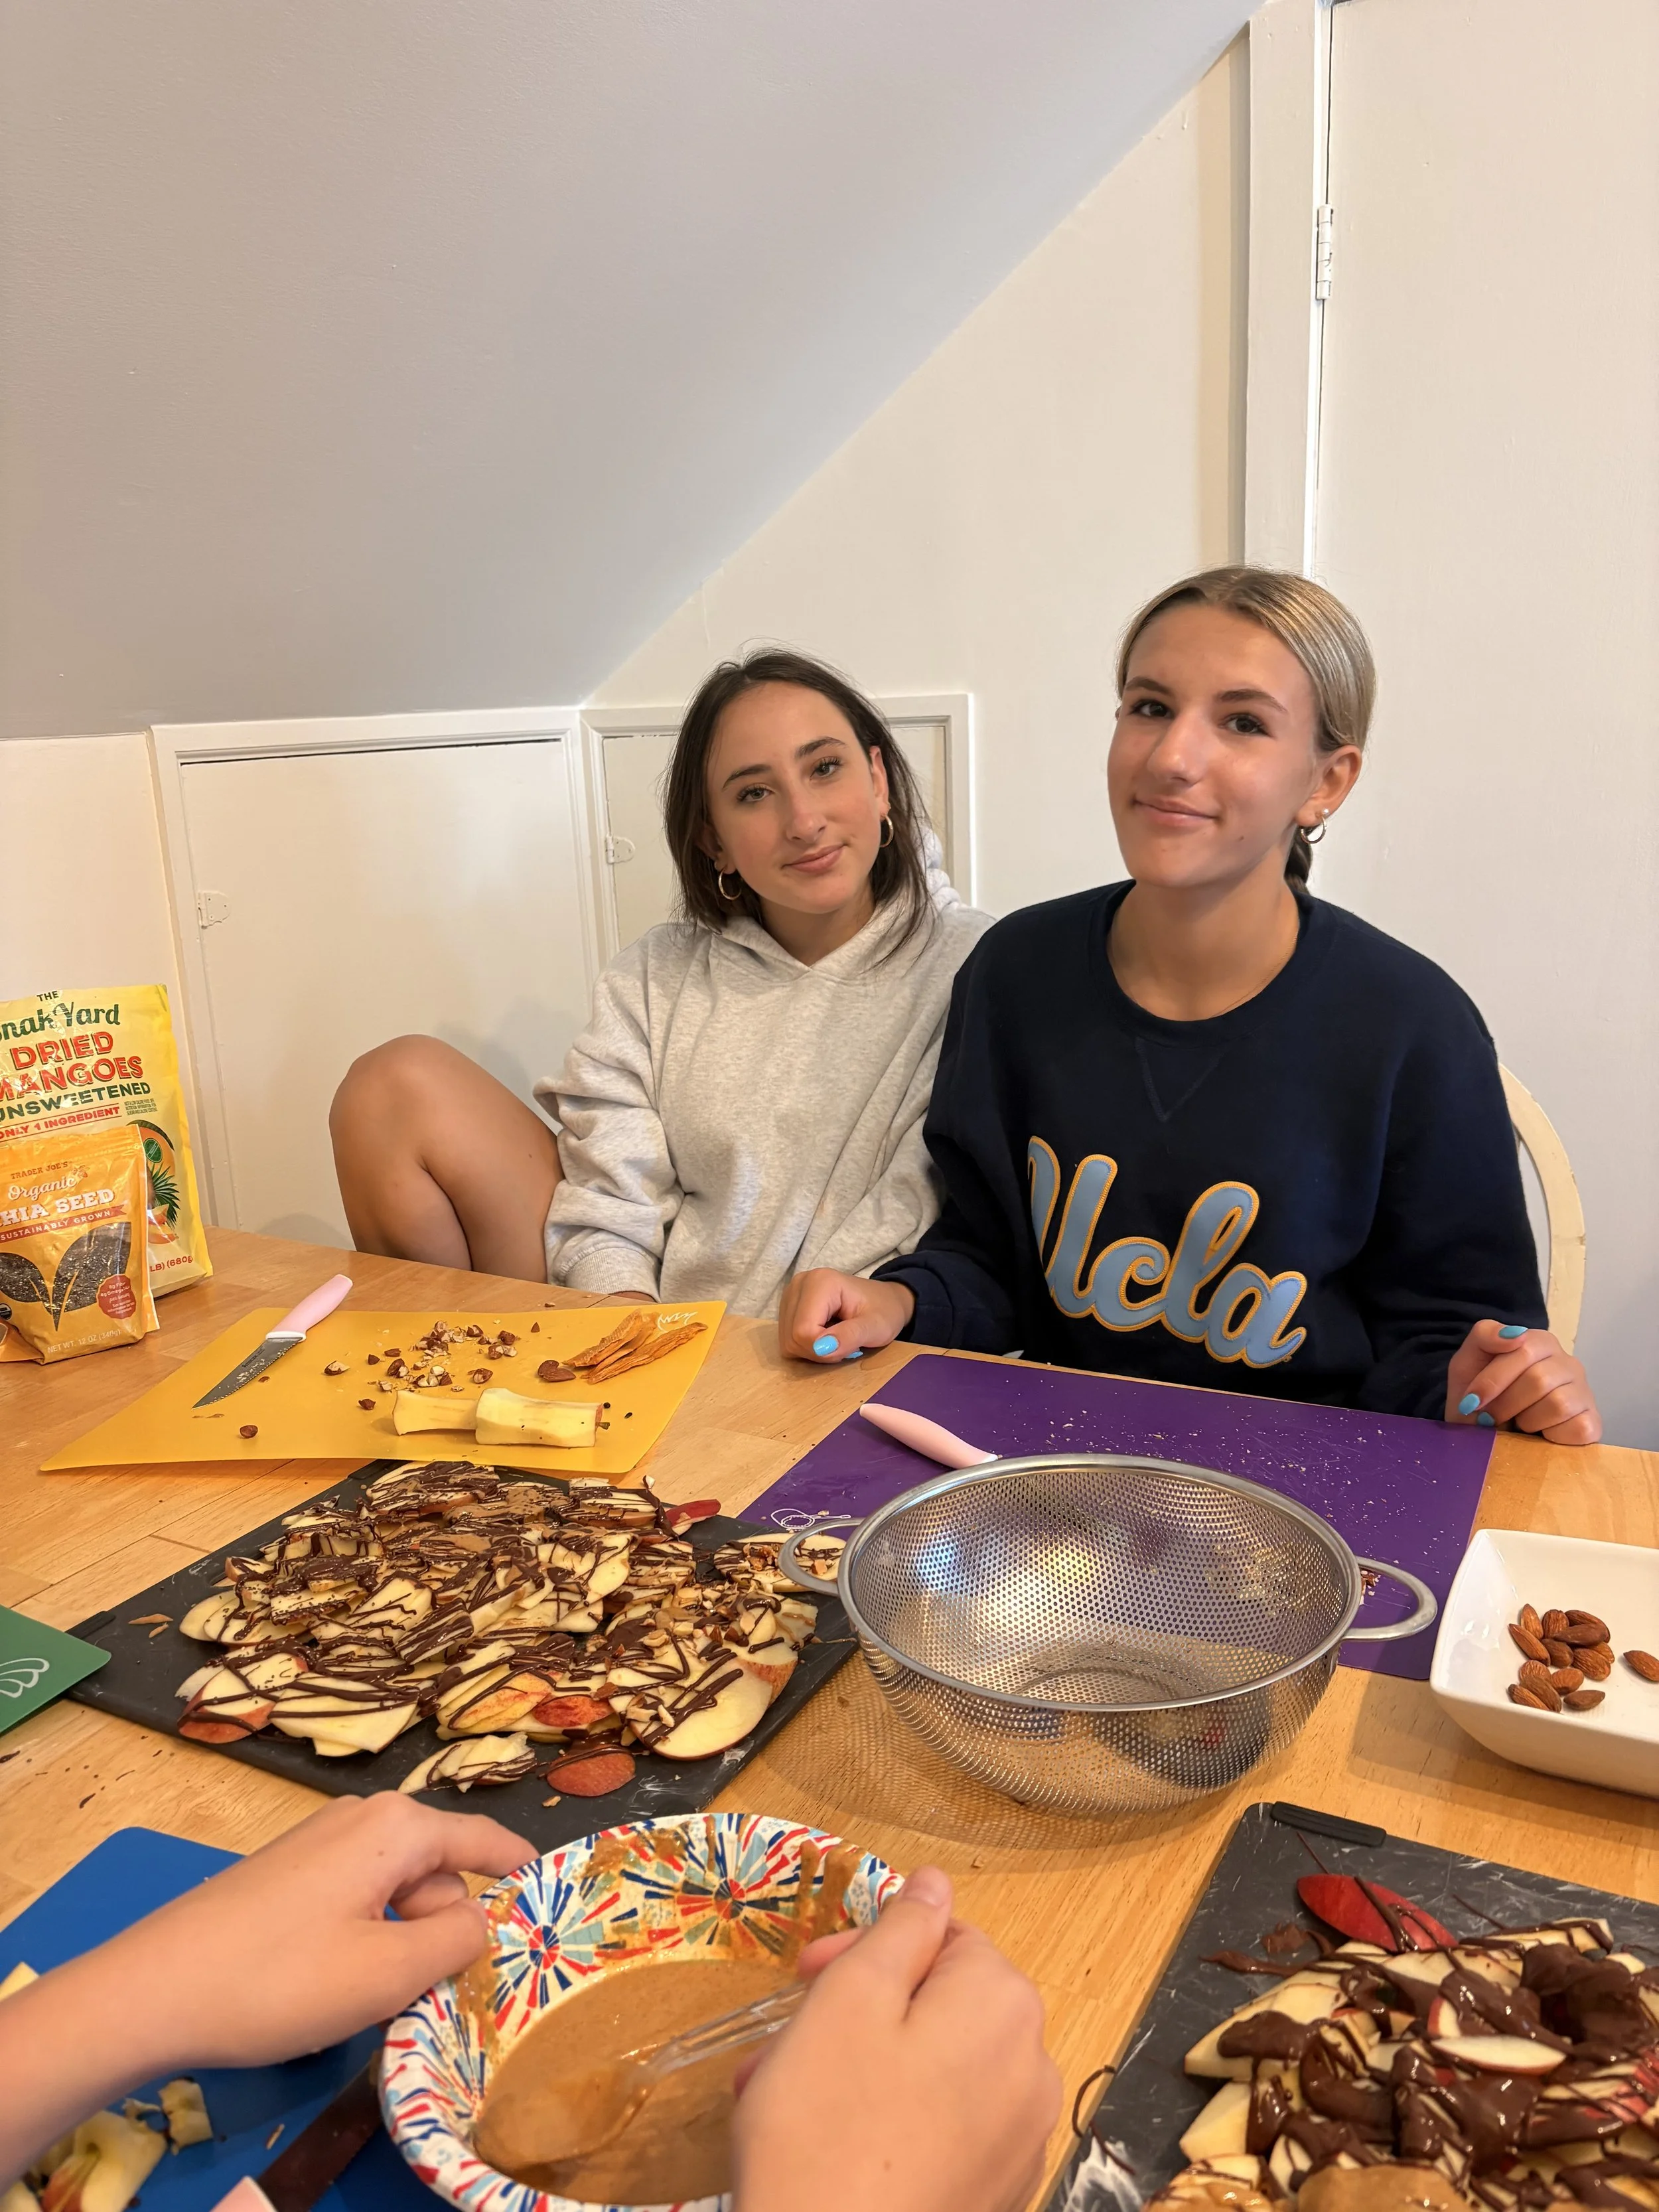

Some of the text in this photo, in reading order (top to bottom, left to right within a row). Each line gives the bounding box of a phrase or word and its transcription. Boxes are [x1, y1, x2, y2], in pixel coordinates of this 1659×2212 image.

[36, 990, 58, 1001] THE
[0, 1001, 121, 1042] nak Yard
[9, 1031, 113, 1070] DRIED
[44, 1106, 120, 1129] INGREDIENT
[11, 1161, 68, 1179] TRADER JOE'S
[8, 1177, 78, 1201] Organic
[0, 1189, 115, 1227] HIA SEED
[1, 1210, 111, 1240] SUSTAINABLY GROWN
[149, 1262, 165, 1272] LB)
[47, 1344, 62, 1354] NET
[88, 1334, 97, 1343] OZ
